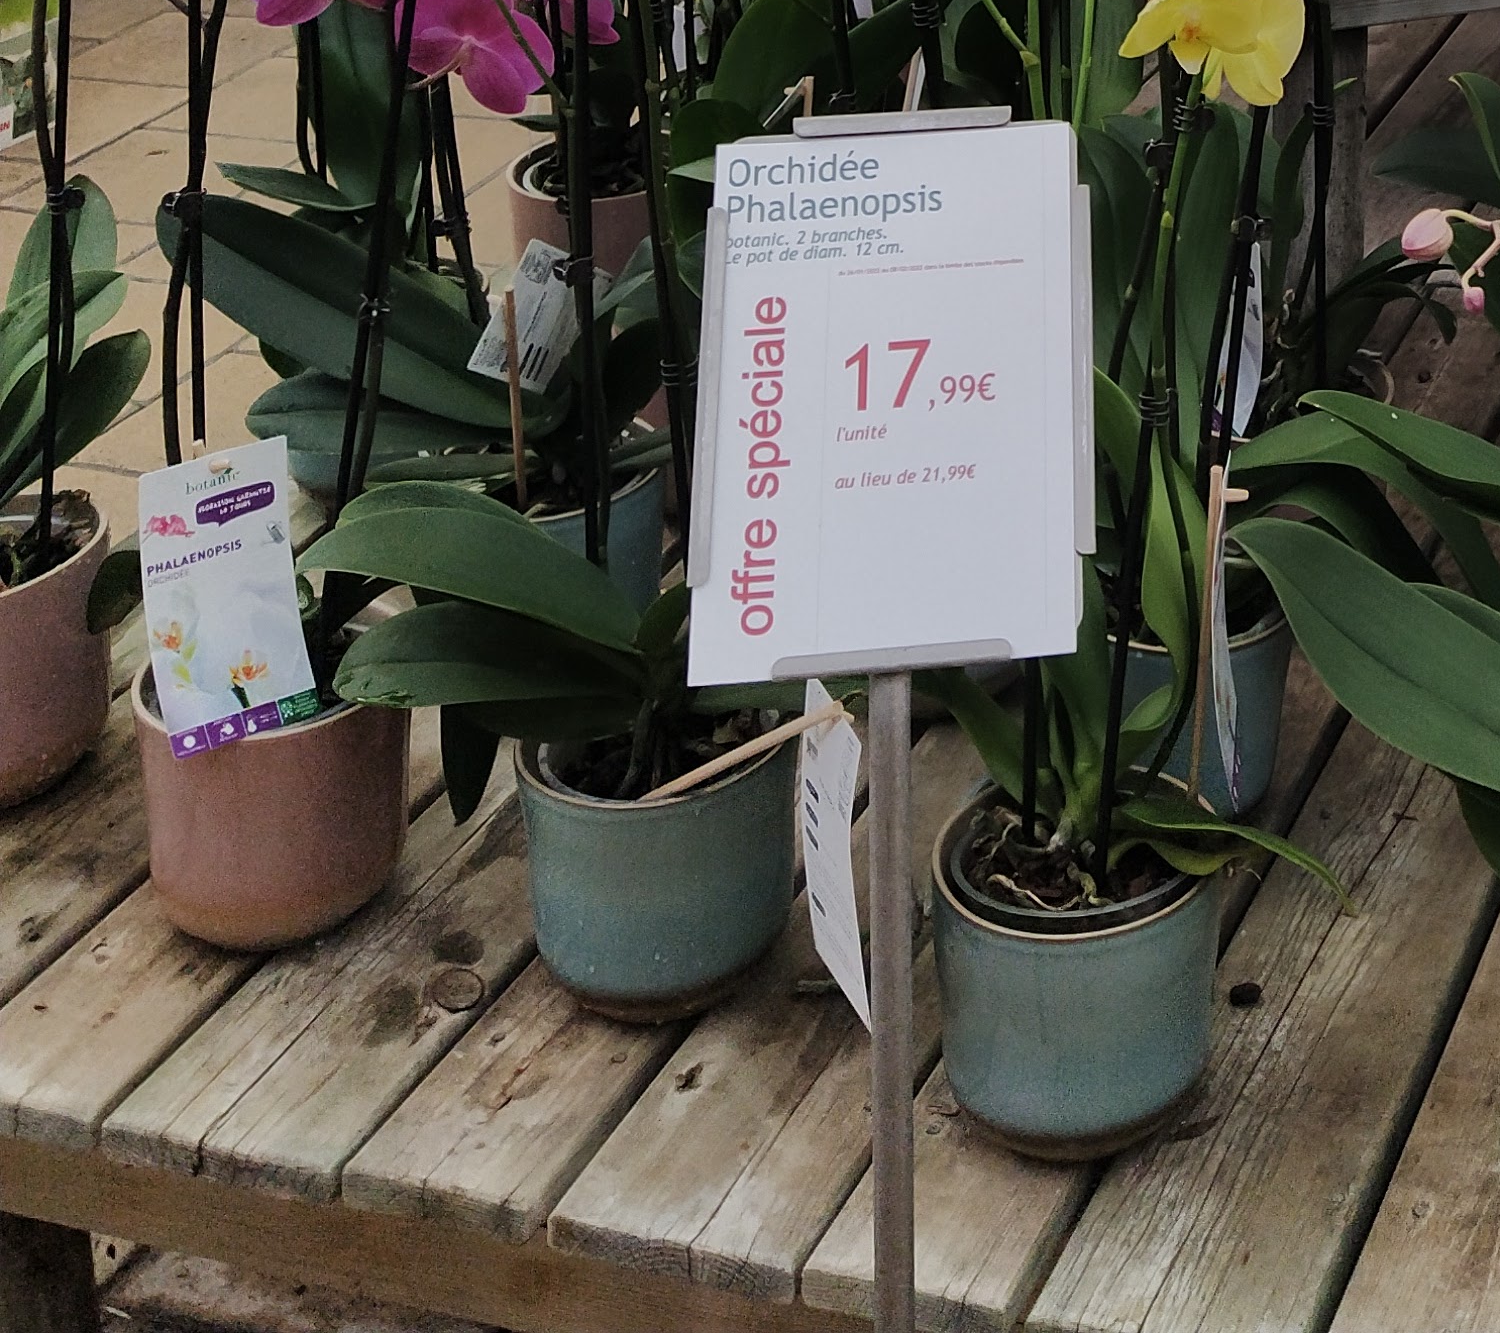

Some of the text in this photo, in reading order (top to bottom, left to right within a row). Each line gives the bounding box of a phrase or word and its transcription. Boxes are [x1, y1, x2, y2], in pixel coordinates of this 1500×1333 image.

[729, 150, 880, 187] Orchidée
[728, 185, 943, 223] Phalaenopsis
[797, 230, 806, 245] 2
[811, 227, 888, 243] branches.
[746, 250, 772, 267] pot
[779, 247, 799, 261] de
[804, 245, 846, 260] diam.
[856, 243, 871, 256] 12
[877, 242, 904, 254] cm.
[836, 424, 888, 442] l'unité
[731, 296, 791, 637] offre spéciale
[834, 463, 976, 490] au lieu de 21,99€
[186, 470, 240, 495] botanic
[147, 539, 243, 577] PHALAENOPSIS
